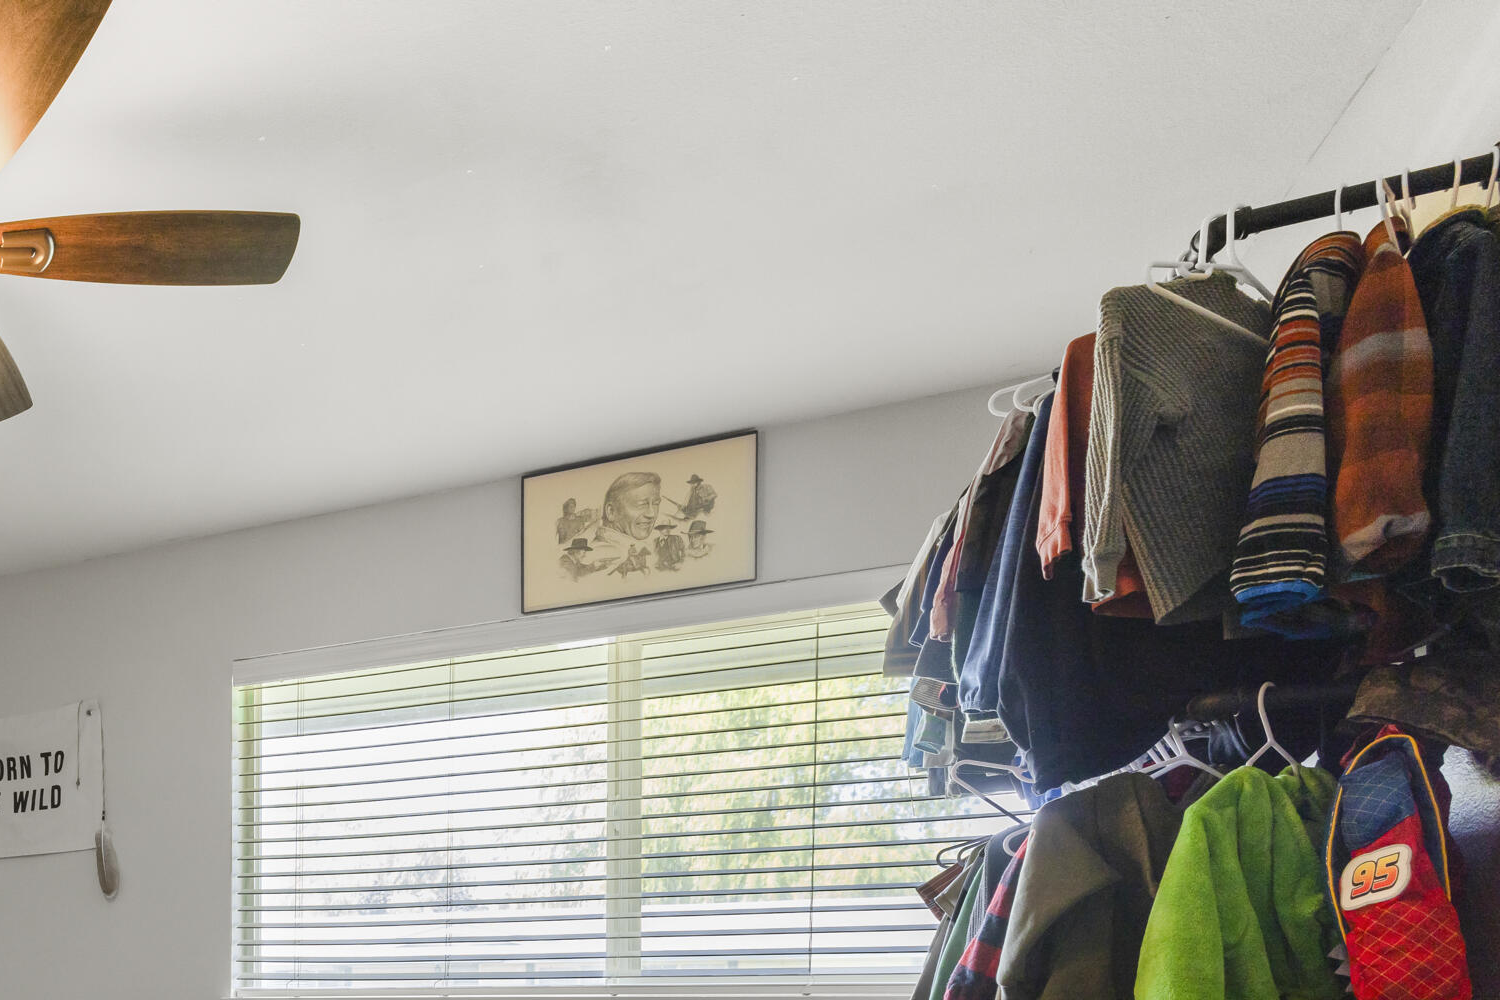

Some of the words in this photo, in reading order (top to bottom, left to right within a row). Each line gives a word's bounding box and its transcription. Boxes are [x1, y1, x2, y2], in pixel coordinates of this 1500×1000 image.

[40, 750, 65, 776] TO
[12, 784, 62, 814] WILD
[1350, 852, 1401, 900] 95
